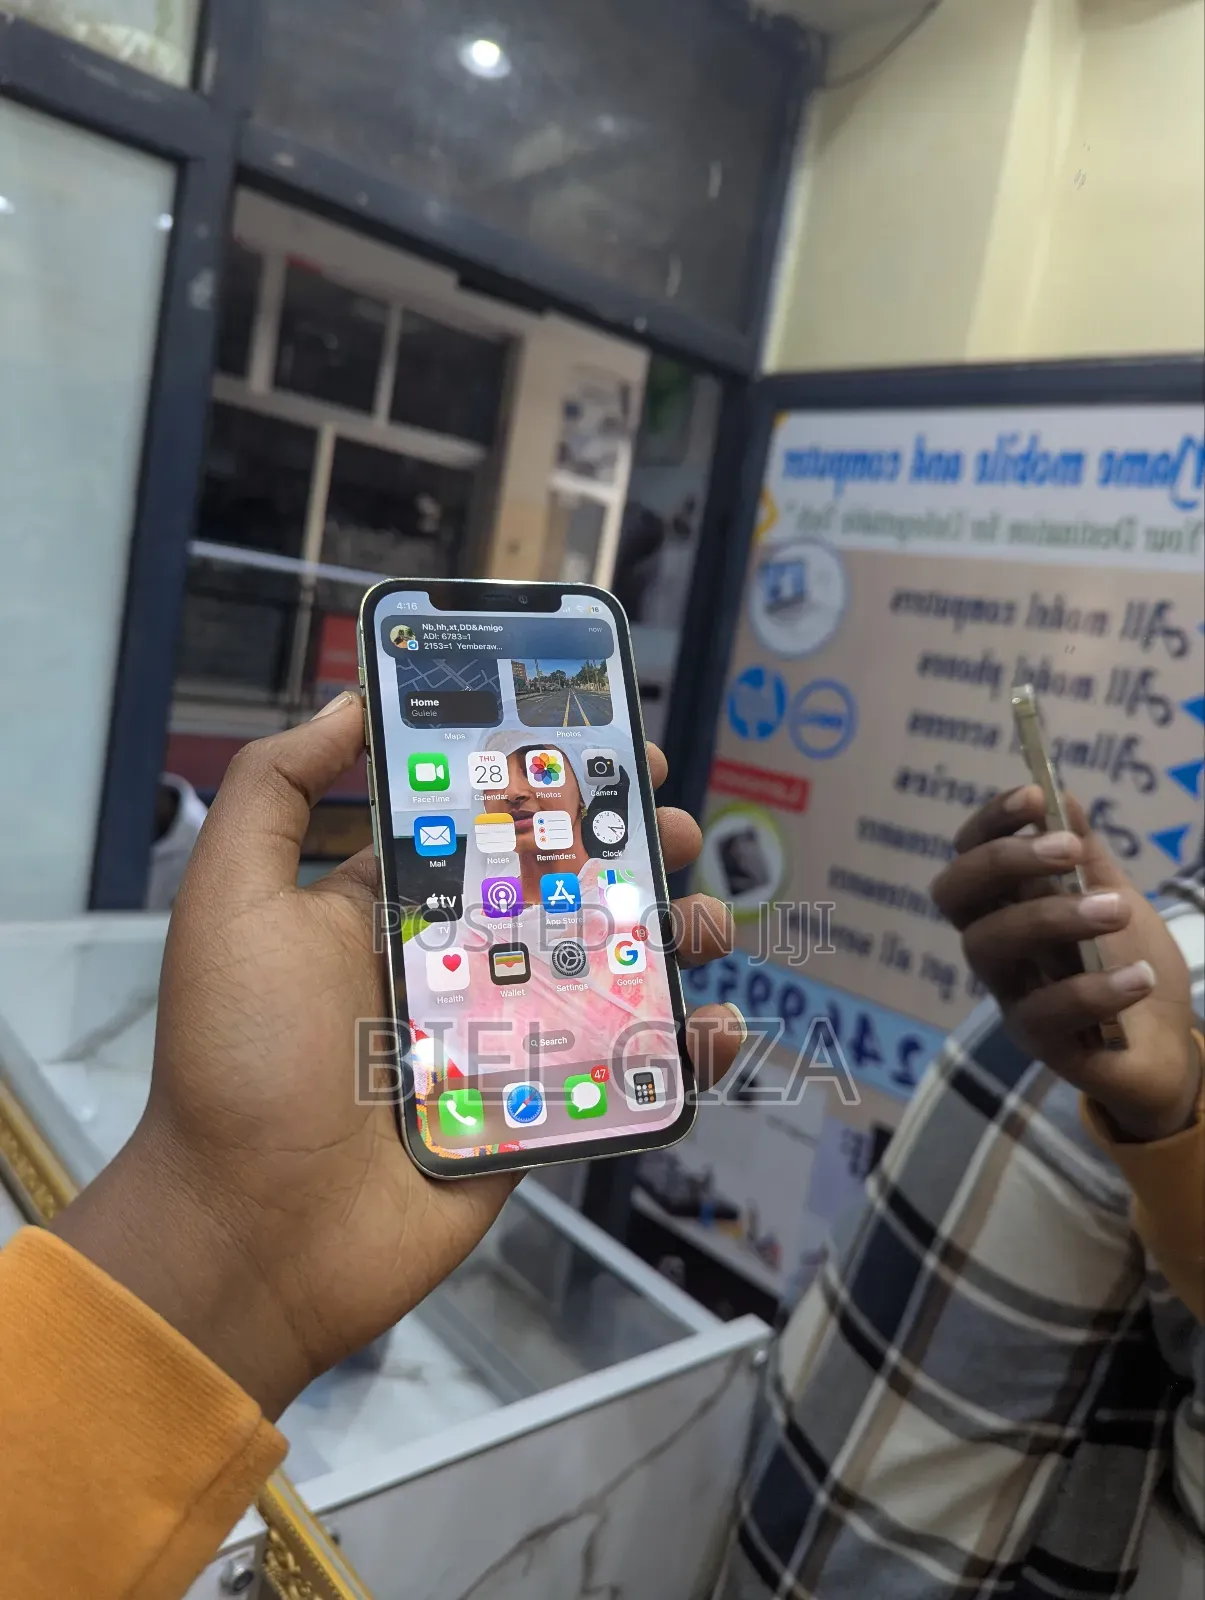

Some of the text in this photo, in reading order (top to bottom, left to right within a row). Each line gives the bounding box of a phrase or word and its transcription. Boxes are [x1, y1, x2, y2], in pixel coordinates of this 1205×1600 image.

[396, 602, 418, 611] 4:16
[442, 633, 471, 641] 6783=1
[424, 642, 452, 650] 2153=1
[410, 698, 440, 707] Home
[445, 732, 466, 741] Maps
[556, 730, 582, 739] Photos
[474, 765, 503, 785] 28
[474, 792, 508, 801] Calendar
[536, 791, 562, 799] Photos
[590, 788, 618, 797] Camera
[412, 795, 450, 803] FaceTime
[536, 852, 576, 861] Reminders
[602, 849, 623, 858] Clock
[430, 859, 446, 868] Mail
[487, 856, 510, 864] Notes
[487, 920, 524, 930] Podcasts
[546, 916, 583, 927] App Store
[439, 926, 450, 934] TV
[617, 977, 644, 987] Google
[556, 982, 588, 993] Settings
[500, 989, 526, 998] Wallet
[436, 992, 464, 1005] Health
[539, 1035, 568, 1047] Search
[594, 1069, 606, 1080] 47
